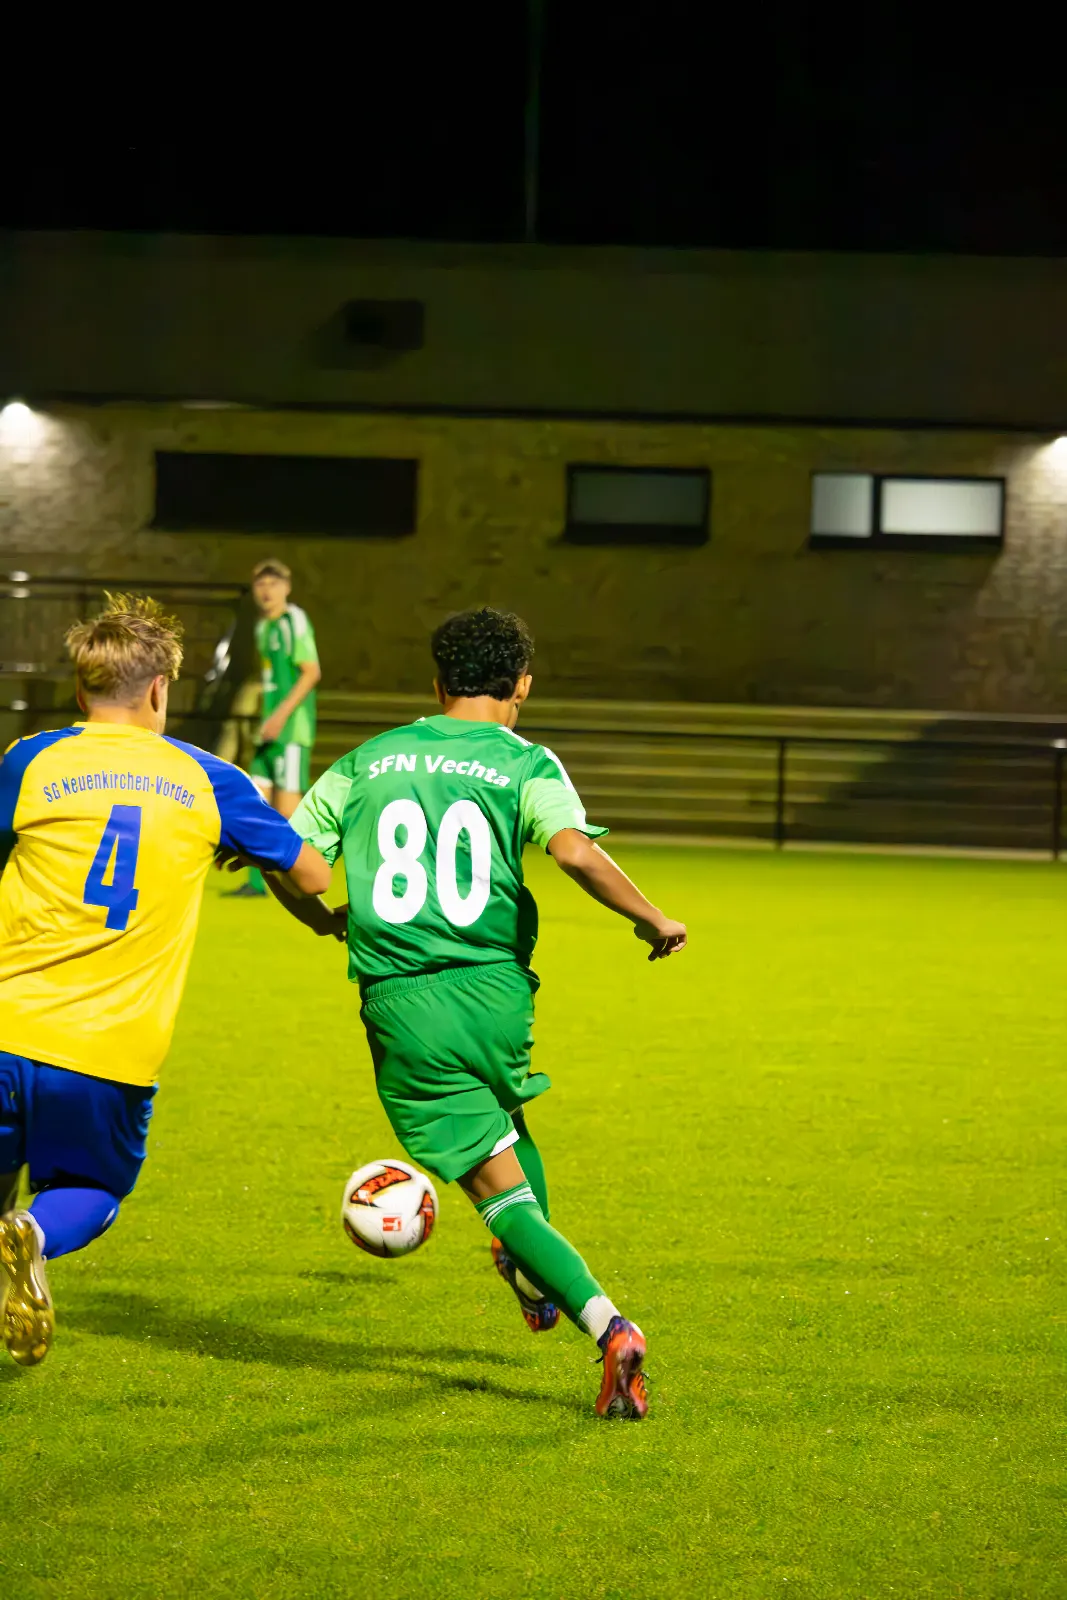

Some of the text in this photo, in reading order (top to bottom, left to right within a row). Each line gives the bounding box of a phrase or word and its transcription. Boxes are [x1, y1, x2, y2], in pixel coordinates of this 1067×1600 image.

[43, 782, 61, 802] SG
[368, 754, 511, 787] SFN Vechta
[83, 804, 142, 931] 4
[372, 799, 491, 926] 80
